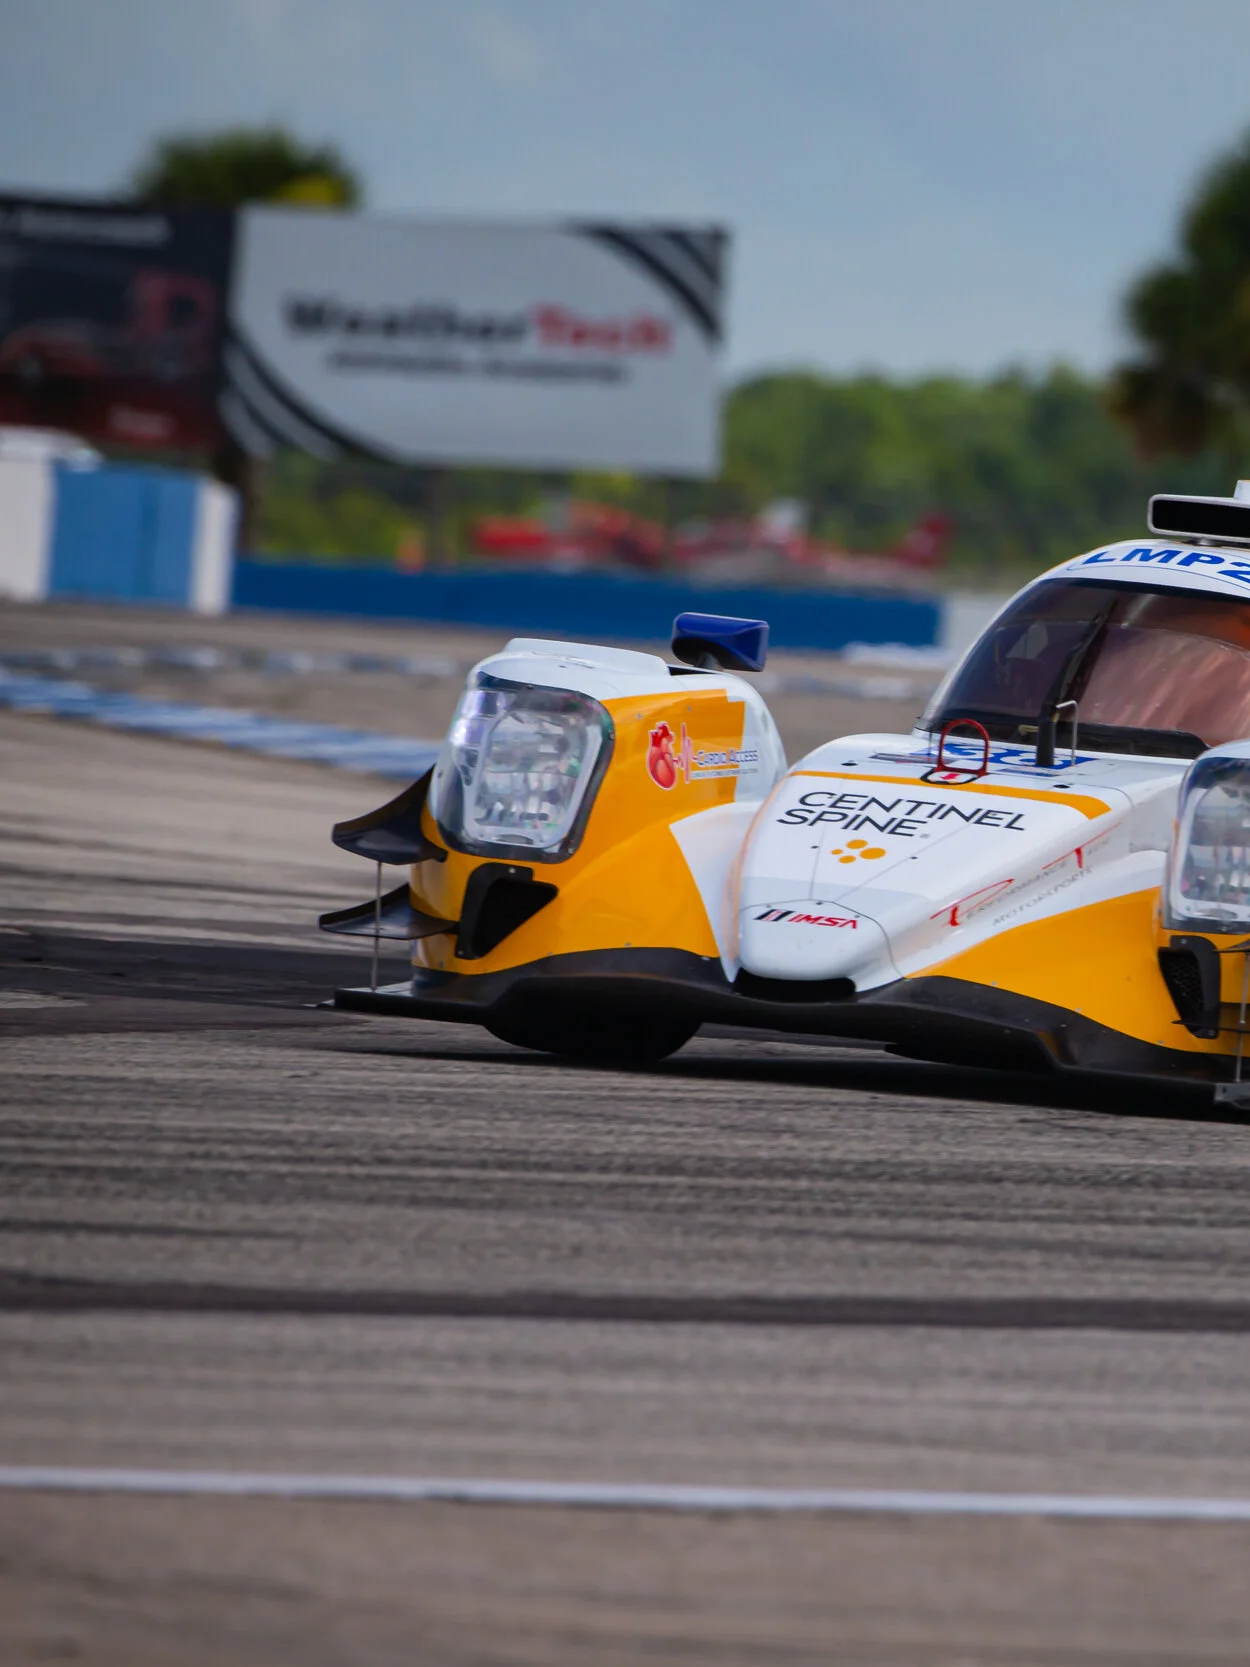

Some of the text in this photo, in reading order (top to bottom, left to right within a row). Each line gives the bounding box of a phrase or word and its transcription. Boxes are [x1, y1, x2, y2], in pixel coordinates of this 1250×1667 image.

[776, 808, 926, 838] SPINE
[797, 791, 1026, 831] CENTINEL
[788, 913, 858, 929] IMSA
